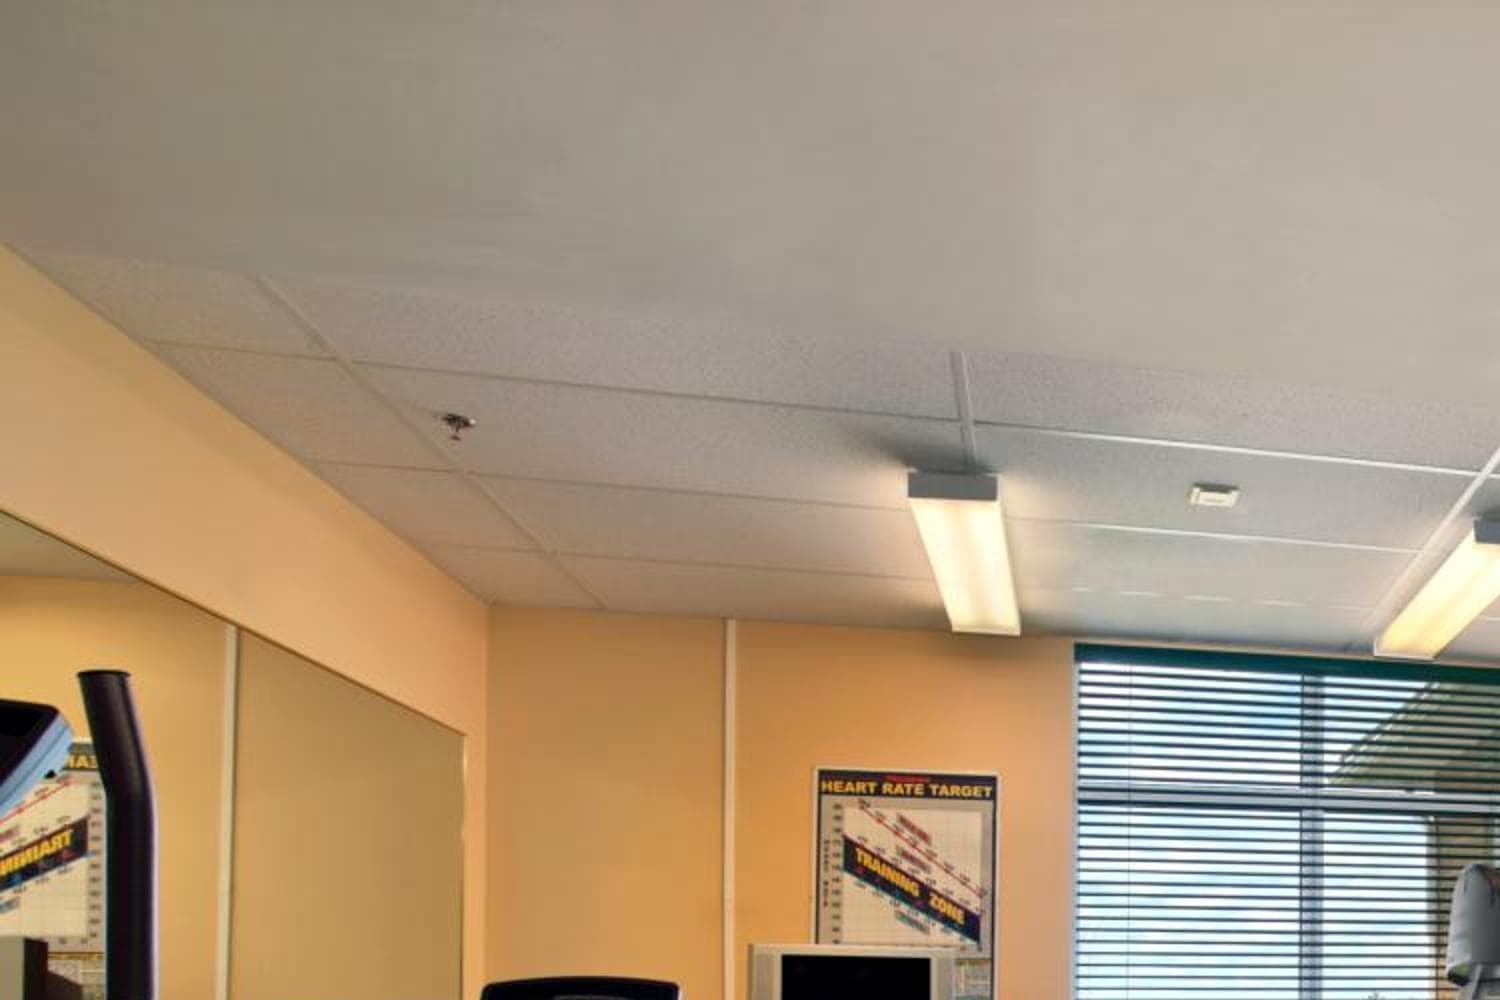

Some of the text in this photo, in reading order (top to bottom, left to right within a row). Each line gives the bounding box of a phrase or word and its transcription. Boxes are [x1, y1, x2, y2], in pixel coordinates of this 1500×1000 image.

[821, 780, 993, 798] HEART RATE TARGET
[855, 847, 920, 897] TRAINING
[930, 894, 966, 925] ZONE
